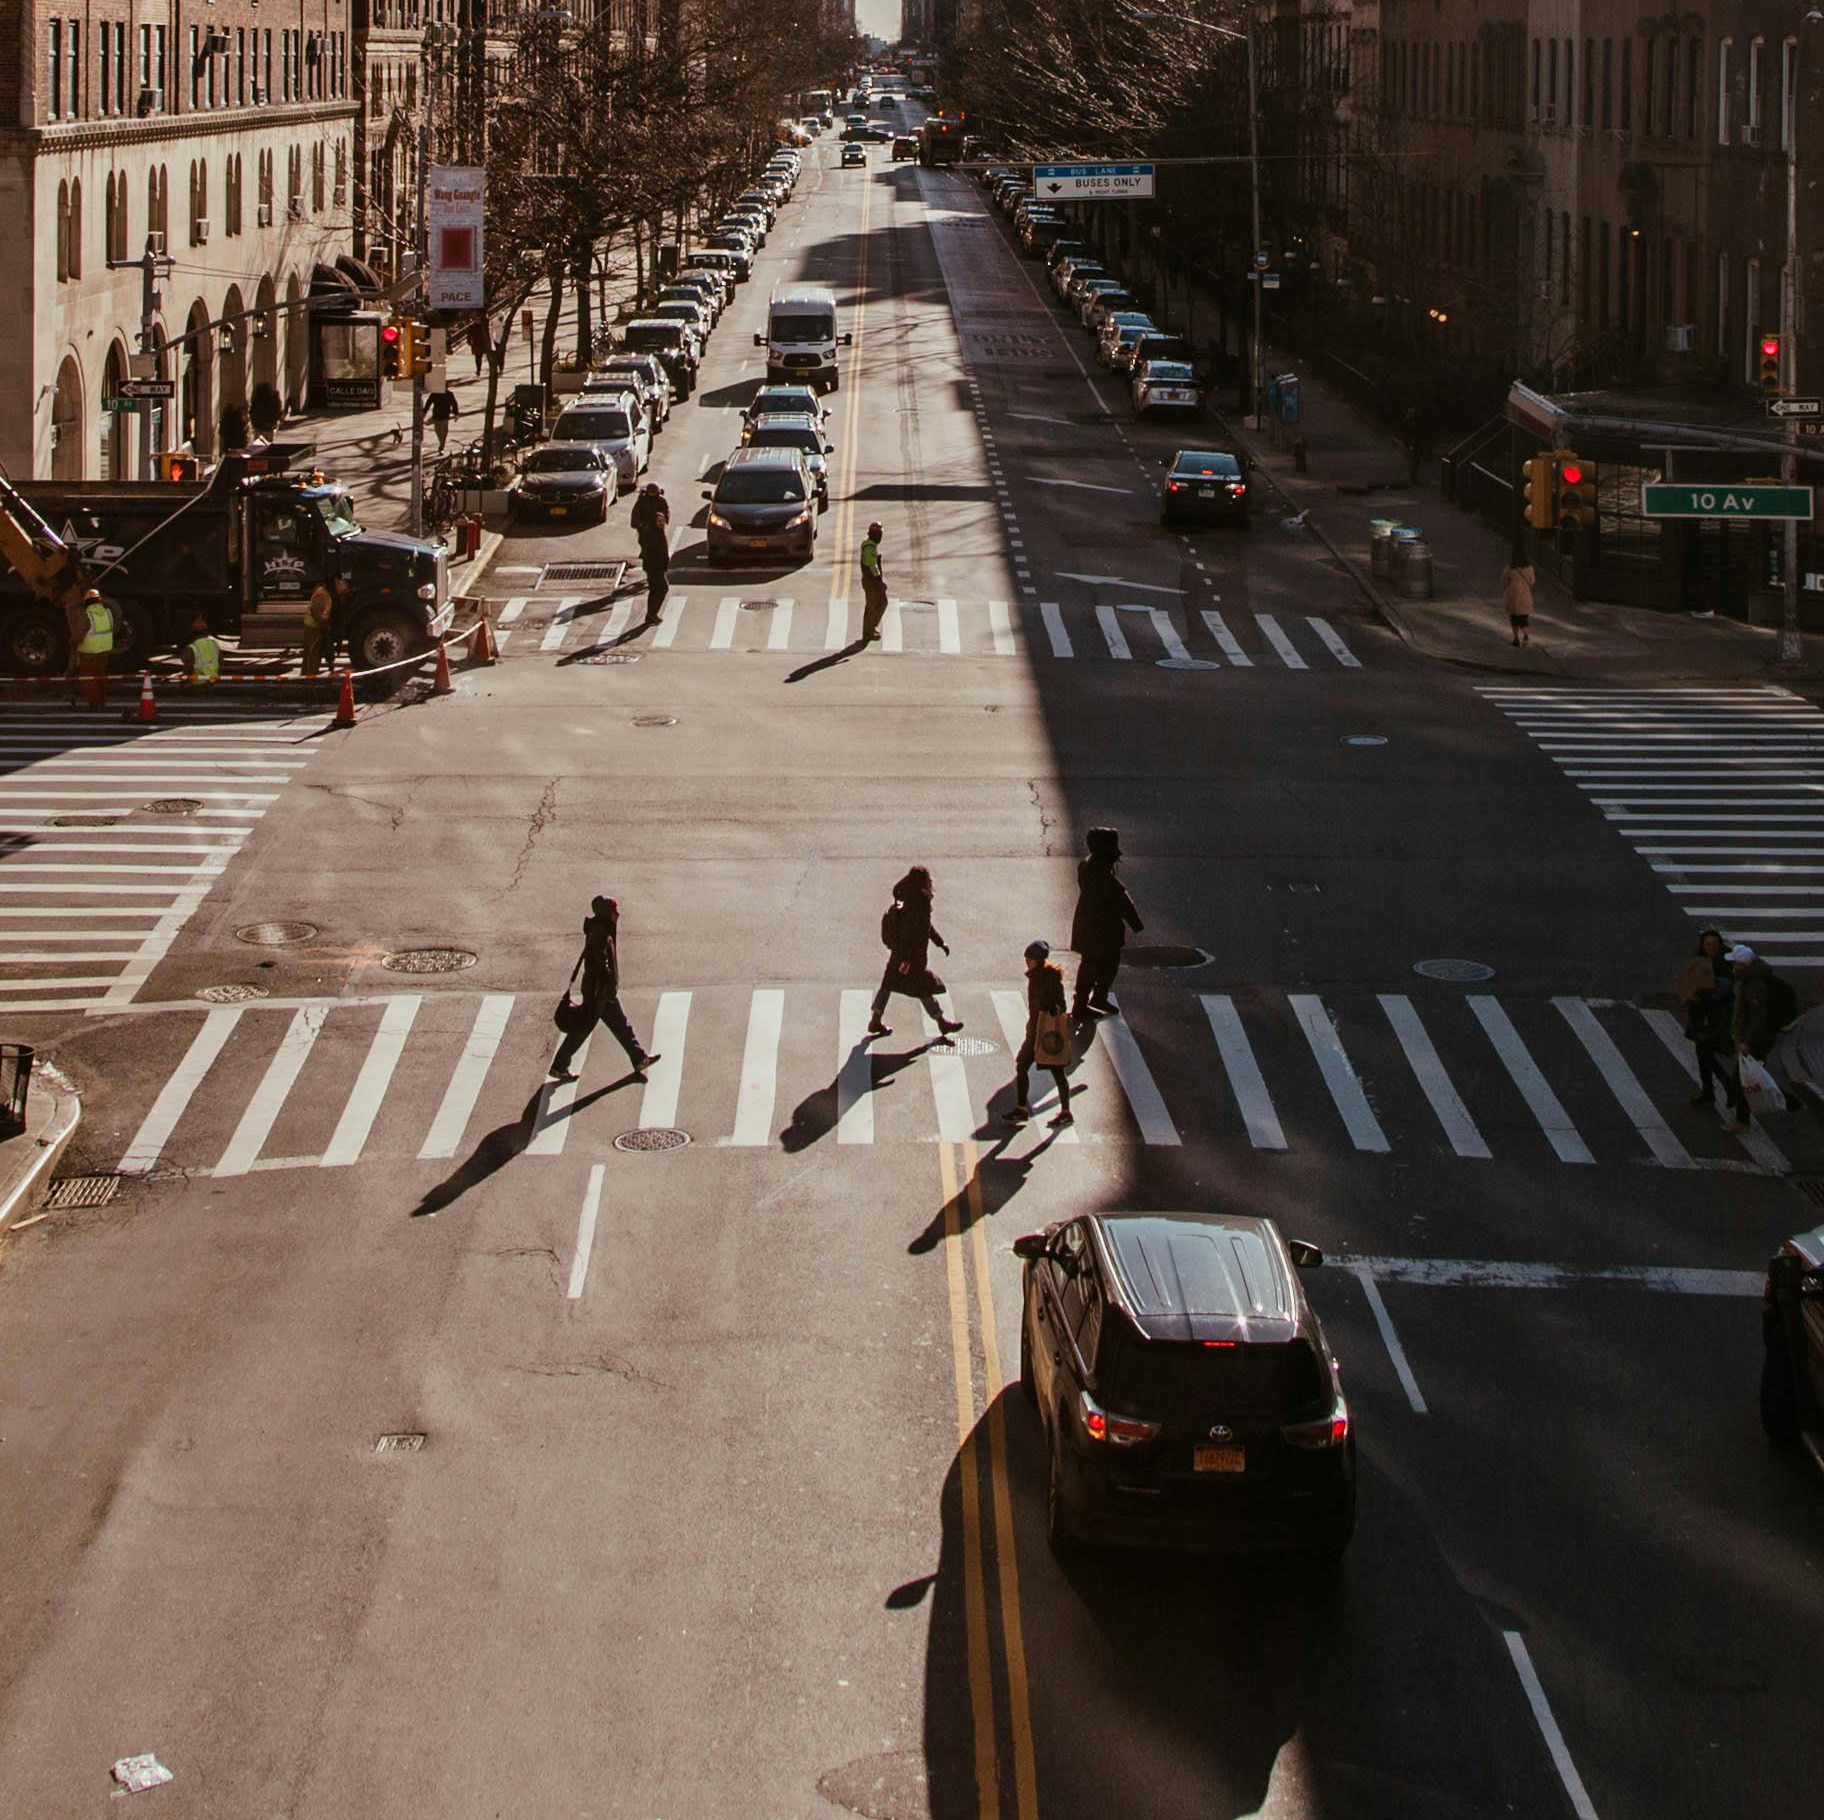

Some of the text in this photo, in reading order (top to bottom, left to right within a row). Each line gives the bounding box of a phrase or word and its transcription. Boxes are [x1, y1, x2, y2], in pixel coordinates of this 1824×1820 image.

[1070, 168, 1088, 176] BUS
[1076, 177, 1141, 188] BUSES ONLY
[441, 292, 472, 302] PACE
[107, 399, 118, 410] 10
[1776, 404, 1791, 412] ONE
[1805, 424, 1818, 435] 10
[1692, 492, 1756, 511] 10 Av
